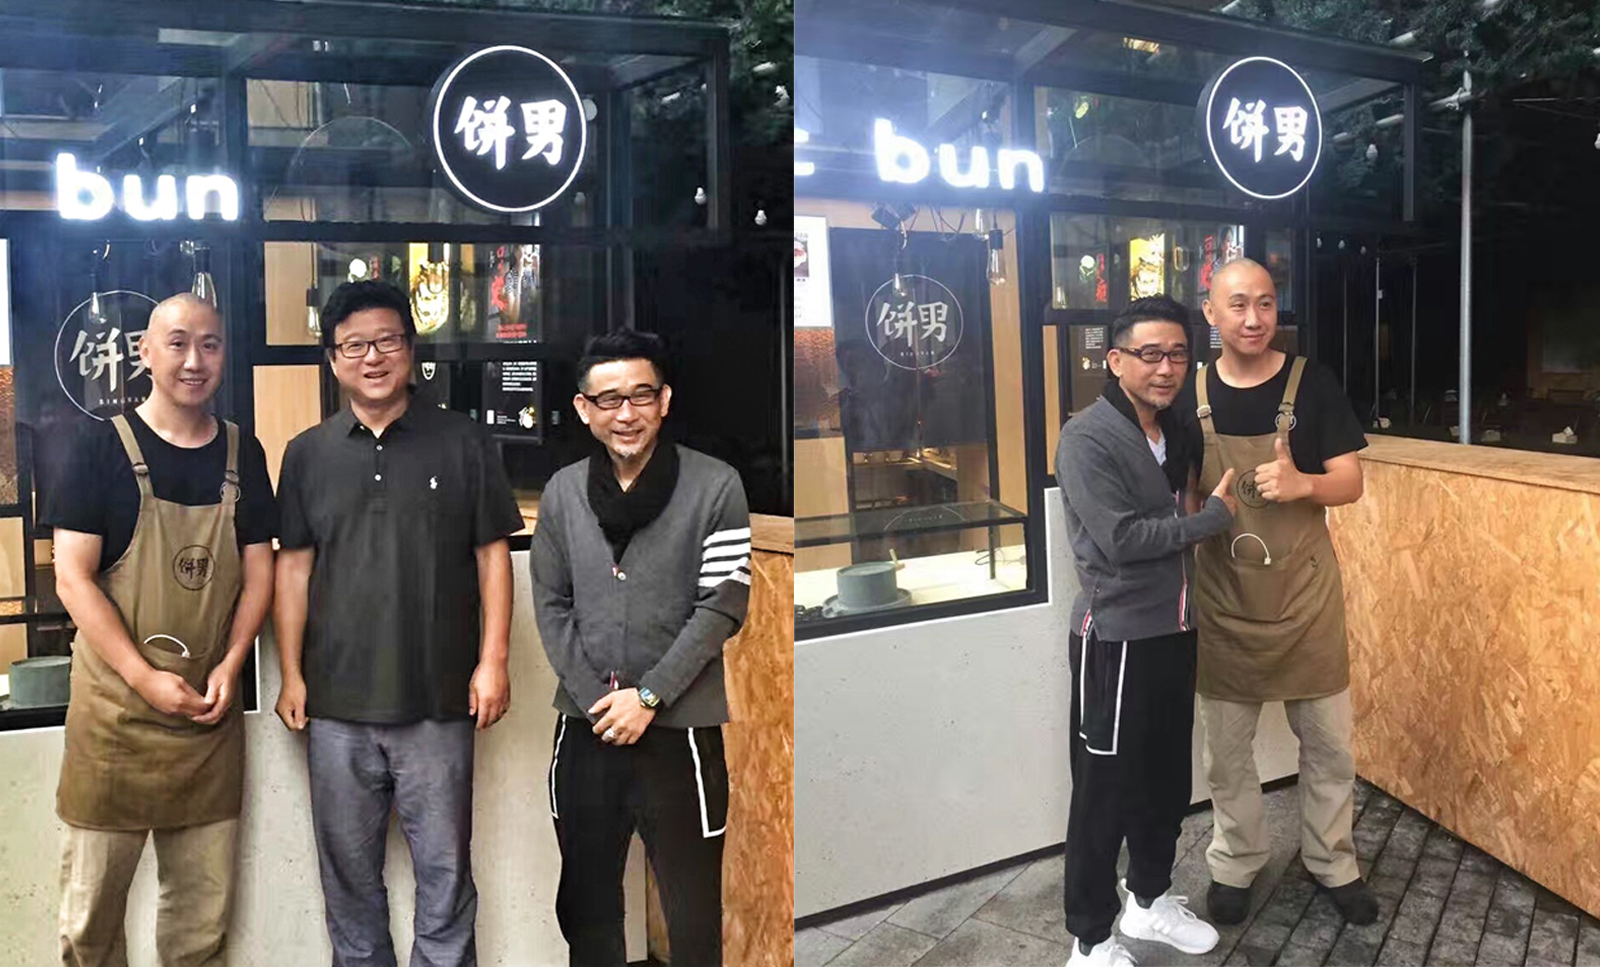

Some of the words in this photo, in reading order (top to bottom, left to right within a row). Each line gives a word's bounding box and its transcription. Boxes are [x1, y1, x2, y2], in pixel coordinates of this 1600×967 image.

[454, 95, 568, 171] 饼男
[874, 117, 1045, 194] bun
[1222, 97, 1308, 164] 饼男
[56, 152, 240, 221] bun
[876, 301, 949, 348] 饼男
[178, 556, 209, 580] 饼男
